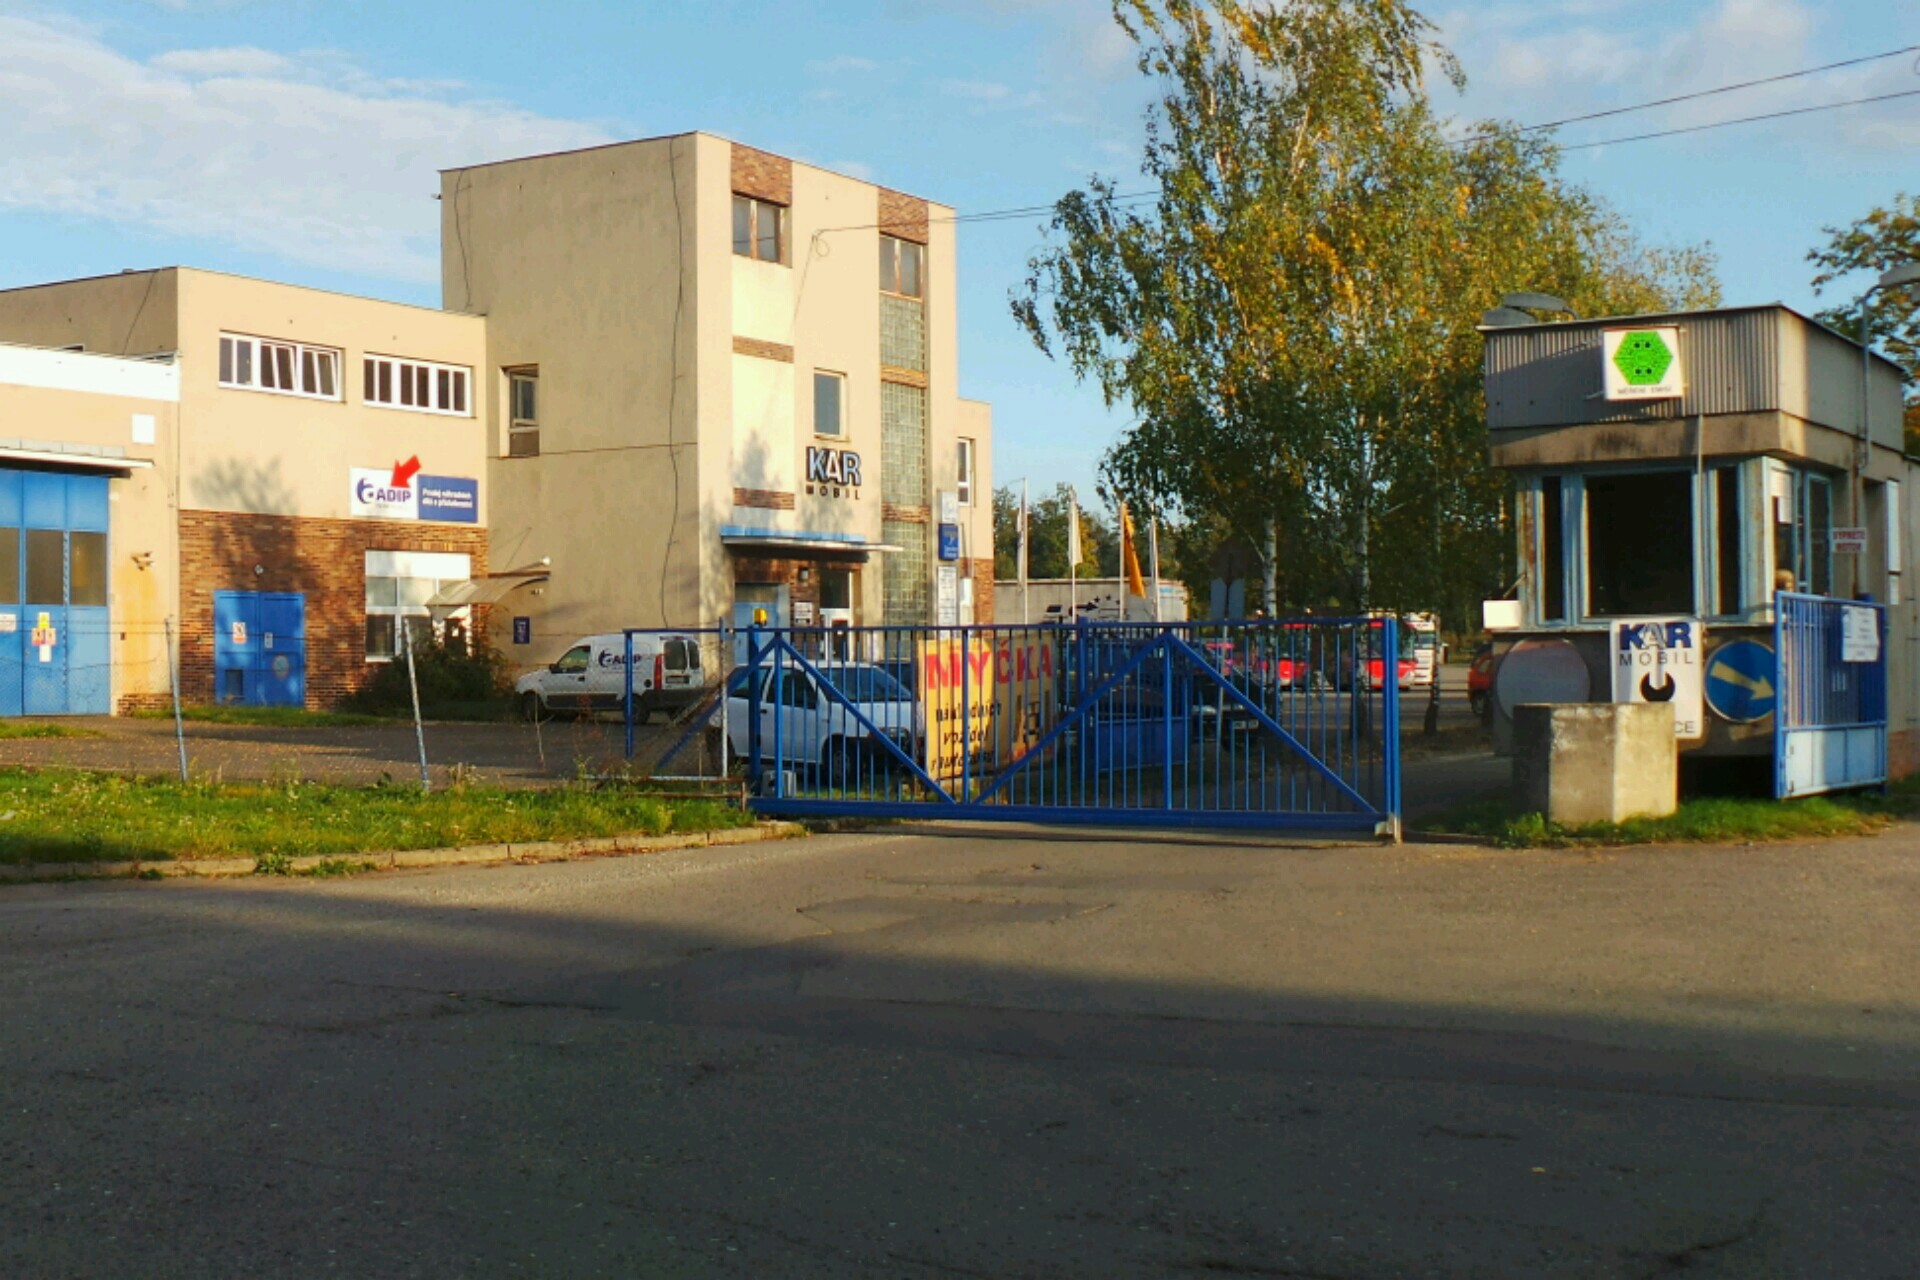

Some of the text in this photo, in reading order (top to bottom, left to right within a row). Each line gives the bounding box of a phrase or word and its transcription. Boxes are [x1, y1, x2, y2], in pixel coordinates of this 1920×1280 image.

[805, 446, 861, 486] KAR
[805, 484, 860, 500] MOBIL
[1619, 622, 1692, 650] KAR
[926, 640, 1052, 690] MYČKA
[1619, 651, 1693, 666] MOBIL
